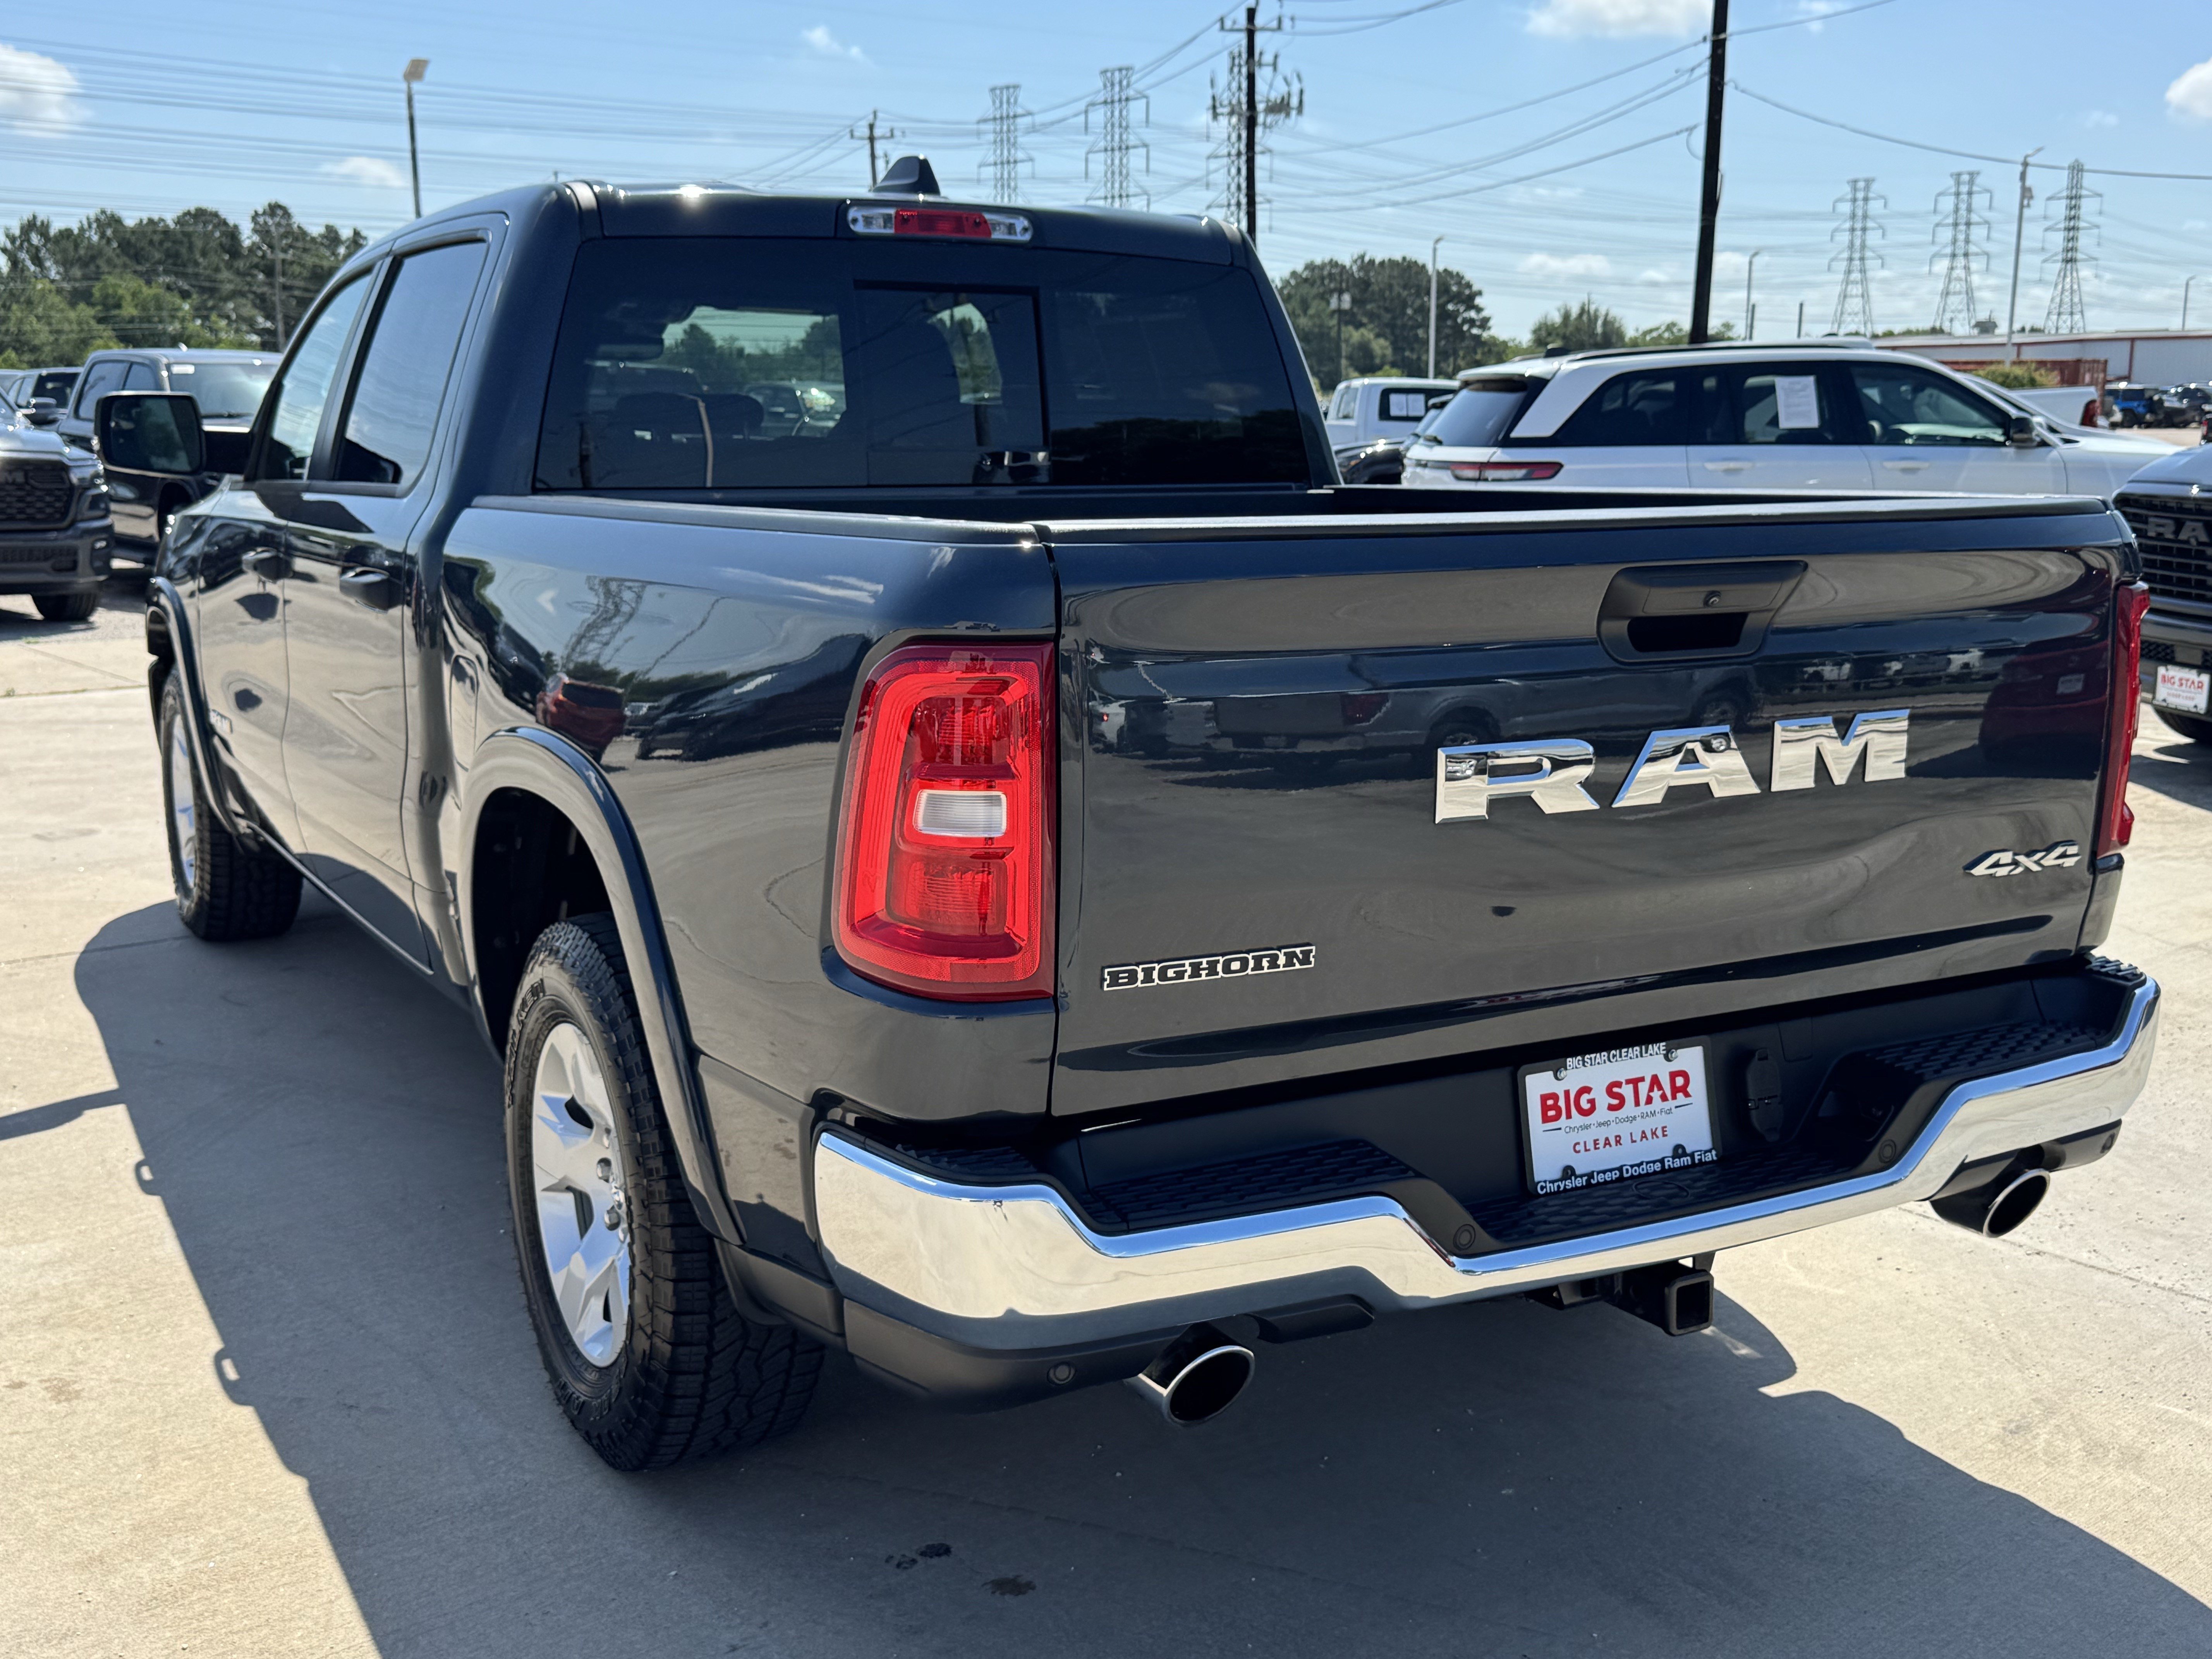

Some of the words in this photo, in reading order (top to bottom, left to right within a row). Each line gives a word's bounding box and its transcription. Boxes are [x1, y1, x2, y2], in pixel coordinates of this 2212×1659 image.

[2161, 674, 2176, 686] BIG
[2178, 677, 2204, 690] STAR
[1435, 709, 1910, 824] RAM
[1104, 946, 1316, 991] BIGHORN
[1566, 1056, 1581, 1070] BIG
[1584, 1052, 1608, 1067] STAR
[1609, 1046, 1639, 1063] CLEAR
[1642, 1042, 1666, 1058] LAKE
[1540, 1085, 1597, 1124] BIG
[1605, 1069, 1692, 1111] STAR
[1564, 1122, 1592, 1134] Chrysler
[1595, 1119, 1611, 1128] Jeep
[1615, 1115, 1637, 1125] Dodge
[1640, 1110, 1657, 1119] RAM
[1660, 1106, 1673, 1115] Fiat
[1573, 1135, 1622, 1154] CLEAR
[1630, 1125, 1668, 1144] LAKE
[1537, 1175, 1587, 1195] Chrysler
[1590, 1168, 1620, 1185] Jeep
[1623, 1161, 1661, 1176] Dodge
[1665, 1154, 1692, 1169] Ram
[1694, 1149, 1717, 1162] Fiat
